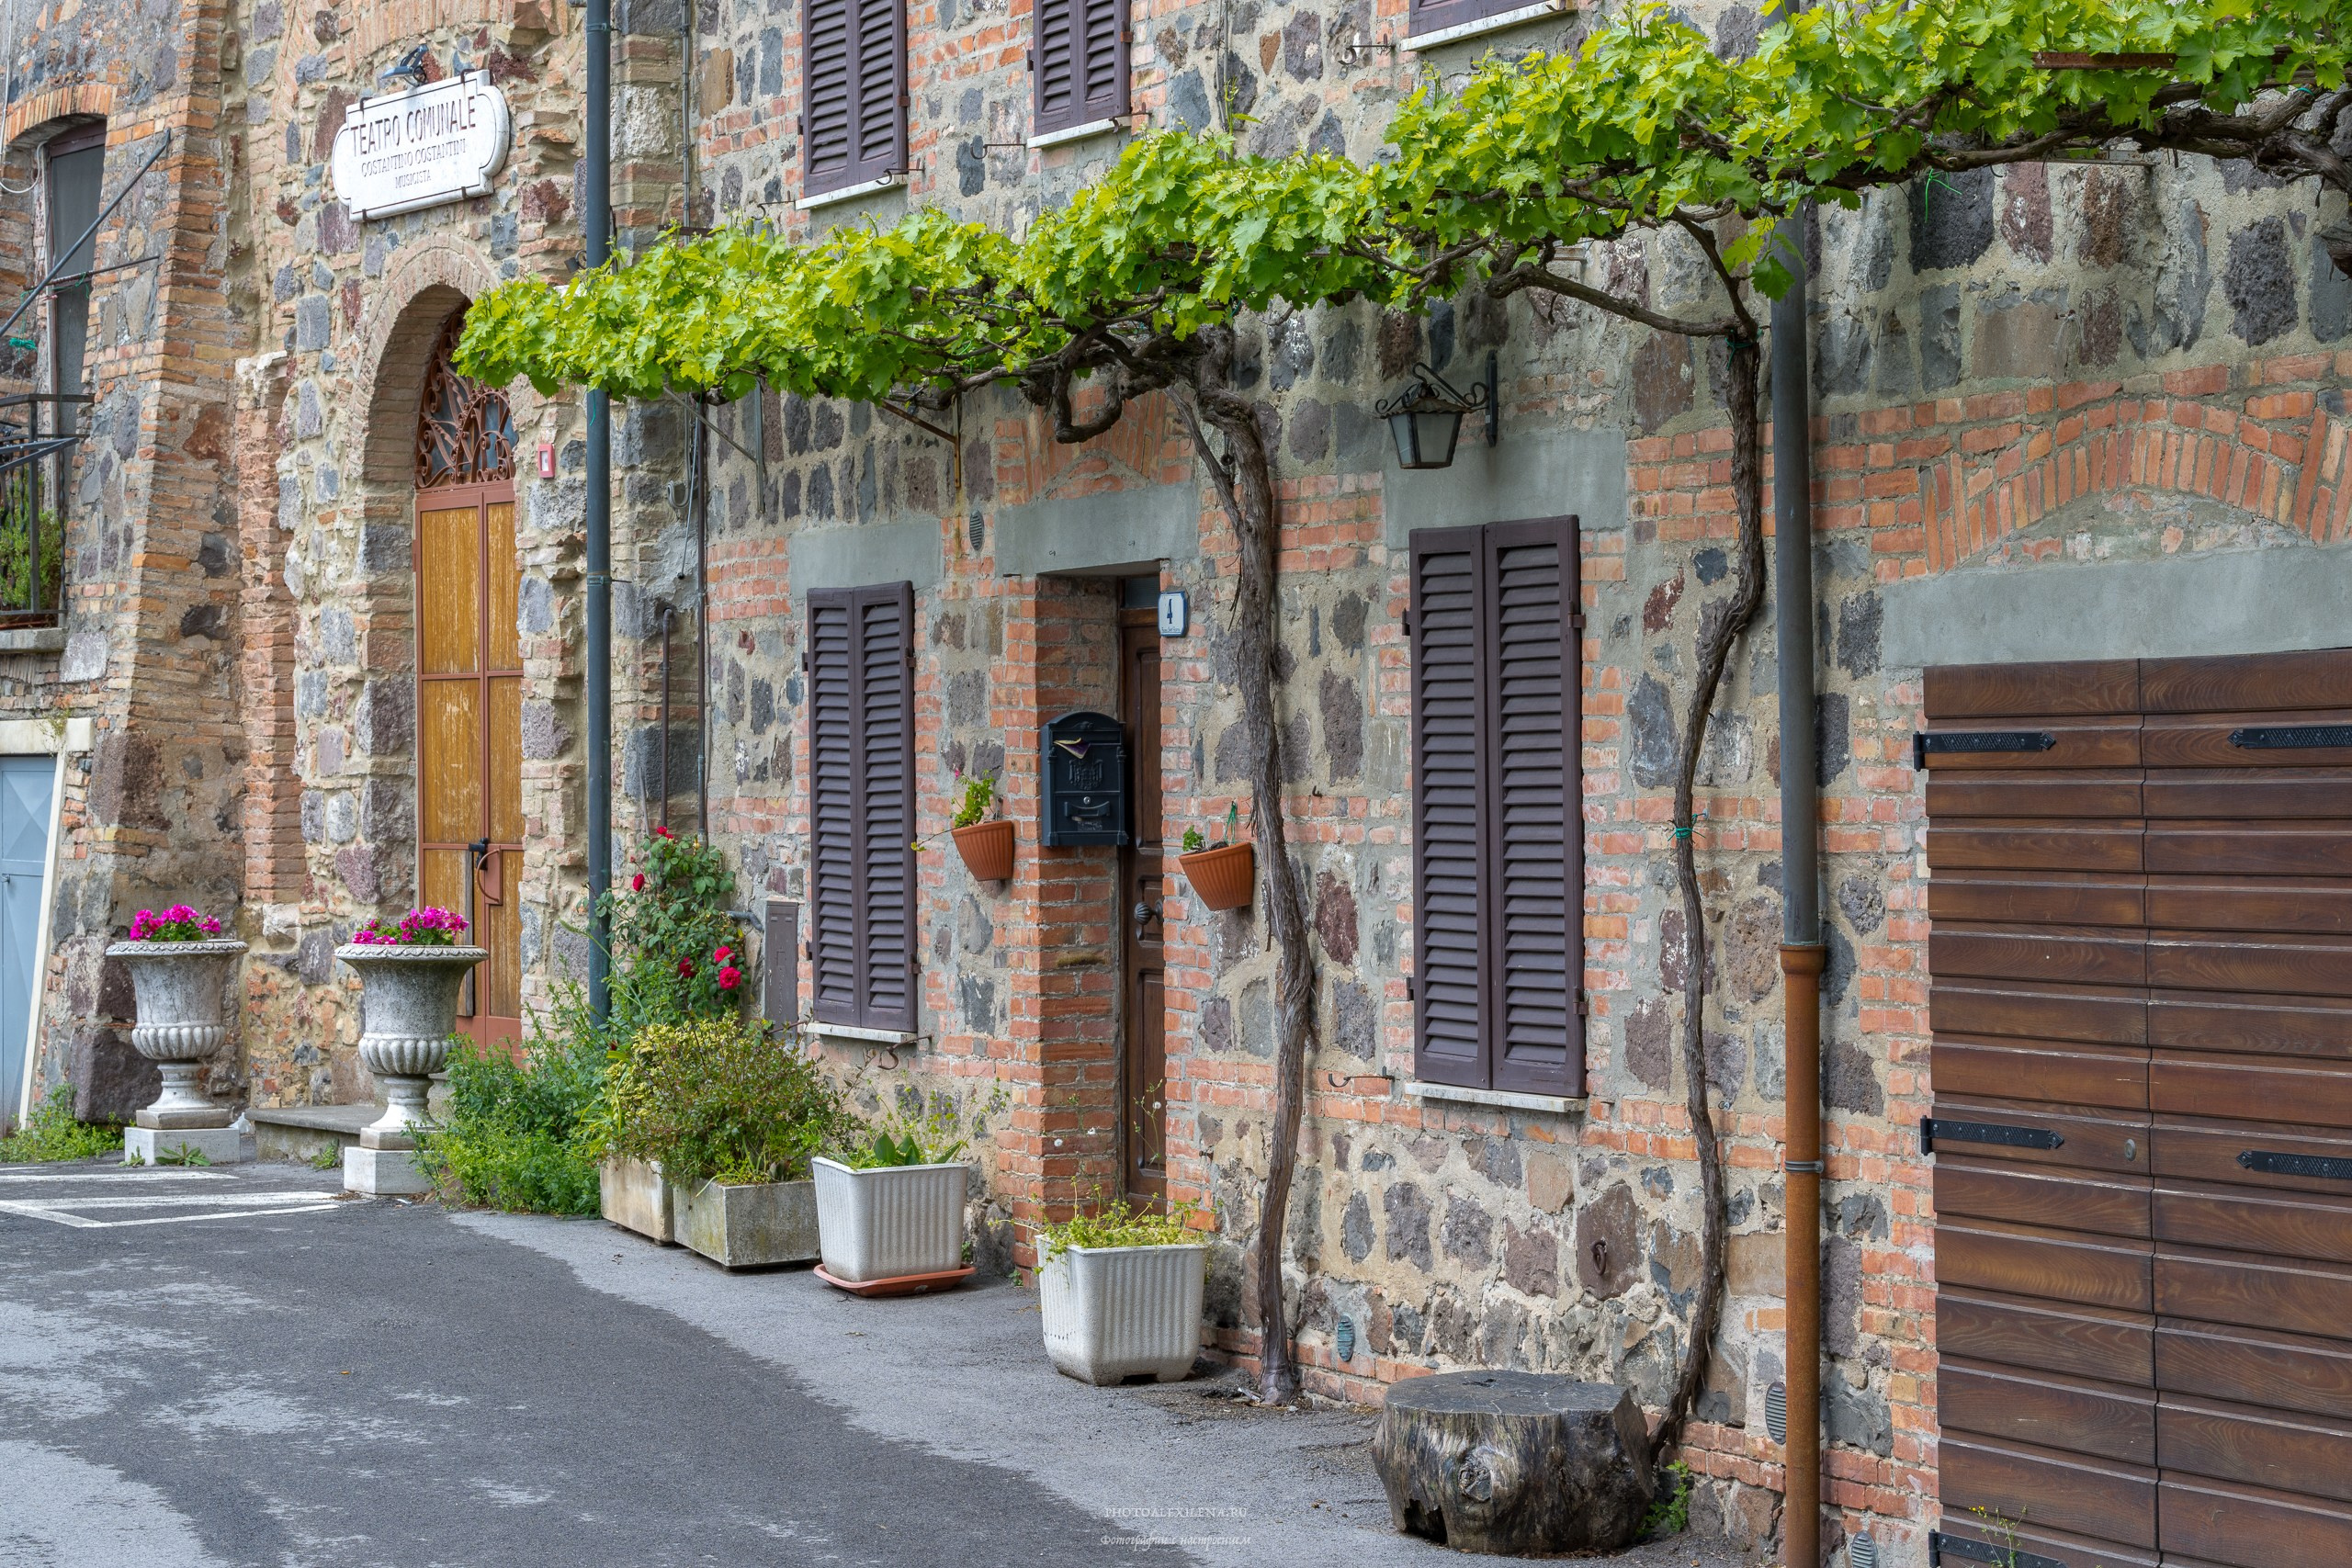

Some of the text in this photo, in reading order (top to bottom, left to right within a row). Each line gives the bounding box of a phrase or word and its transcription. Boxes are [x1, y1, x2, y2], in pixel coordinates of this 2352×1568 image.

[350, 96, 477, 157] TEATRO COMUNALE
[361, 139, 466, 178] COSTANTINO COSTANTINI
[394, 169, 432, 189] MUSICISTA
[1167, 598, 1172, 624] 4
